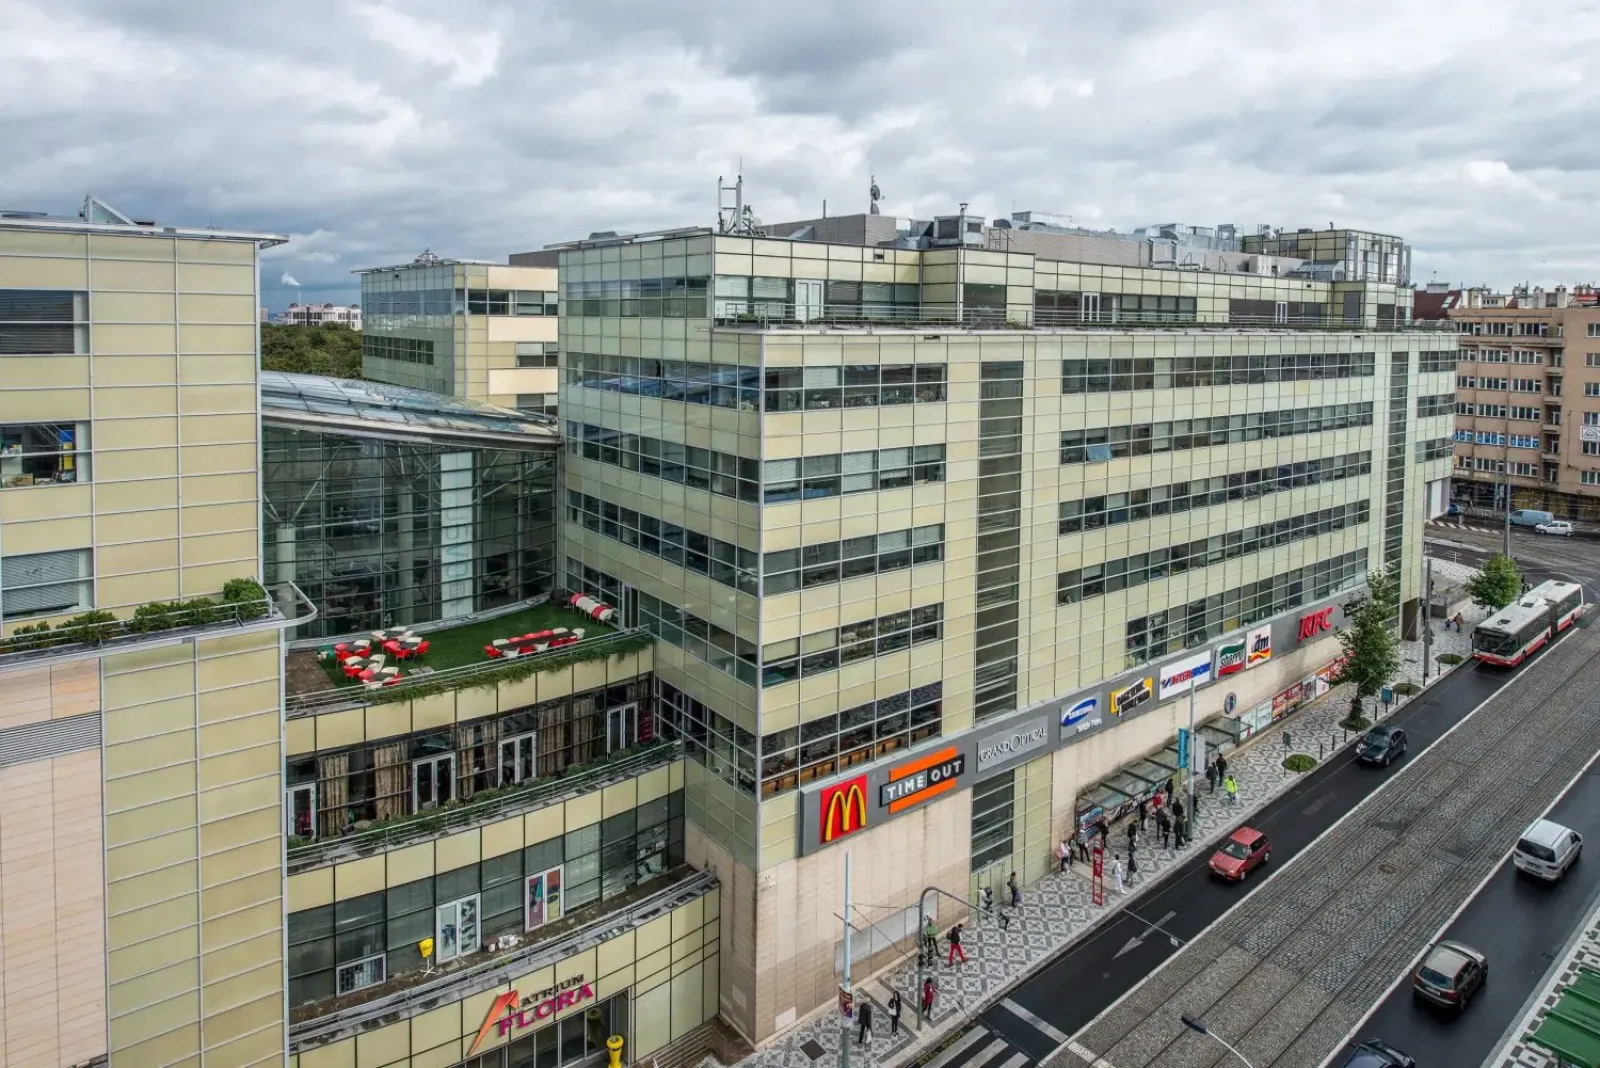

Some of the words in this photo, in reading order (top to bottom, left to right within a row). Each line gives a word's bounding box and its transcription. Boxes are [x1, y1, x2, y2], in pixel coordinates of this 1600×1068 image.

[1297, 606, 1333, 642] KFC
[1253, 634, 1269, 653] dm
[887, 775, 924, 799] TIME
[930, 760, 962, 782] OUT
[520, 973, 584, 1008] ATRIUM
[498, 983, 594, 1037] FLORA
